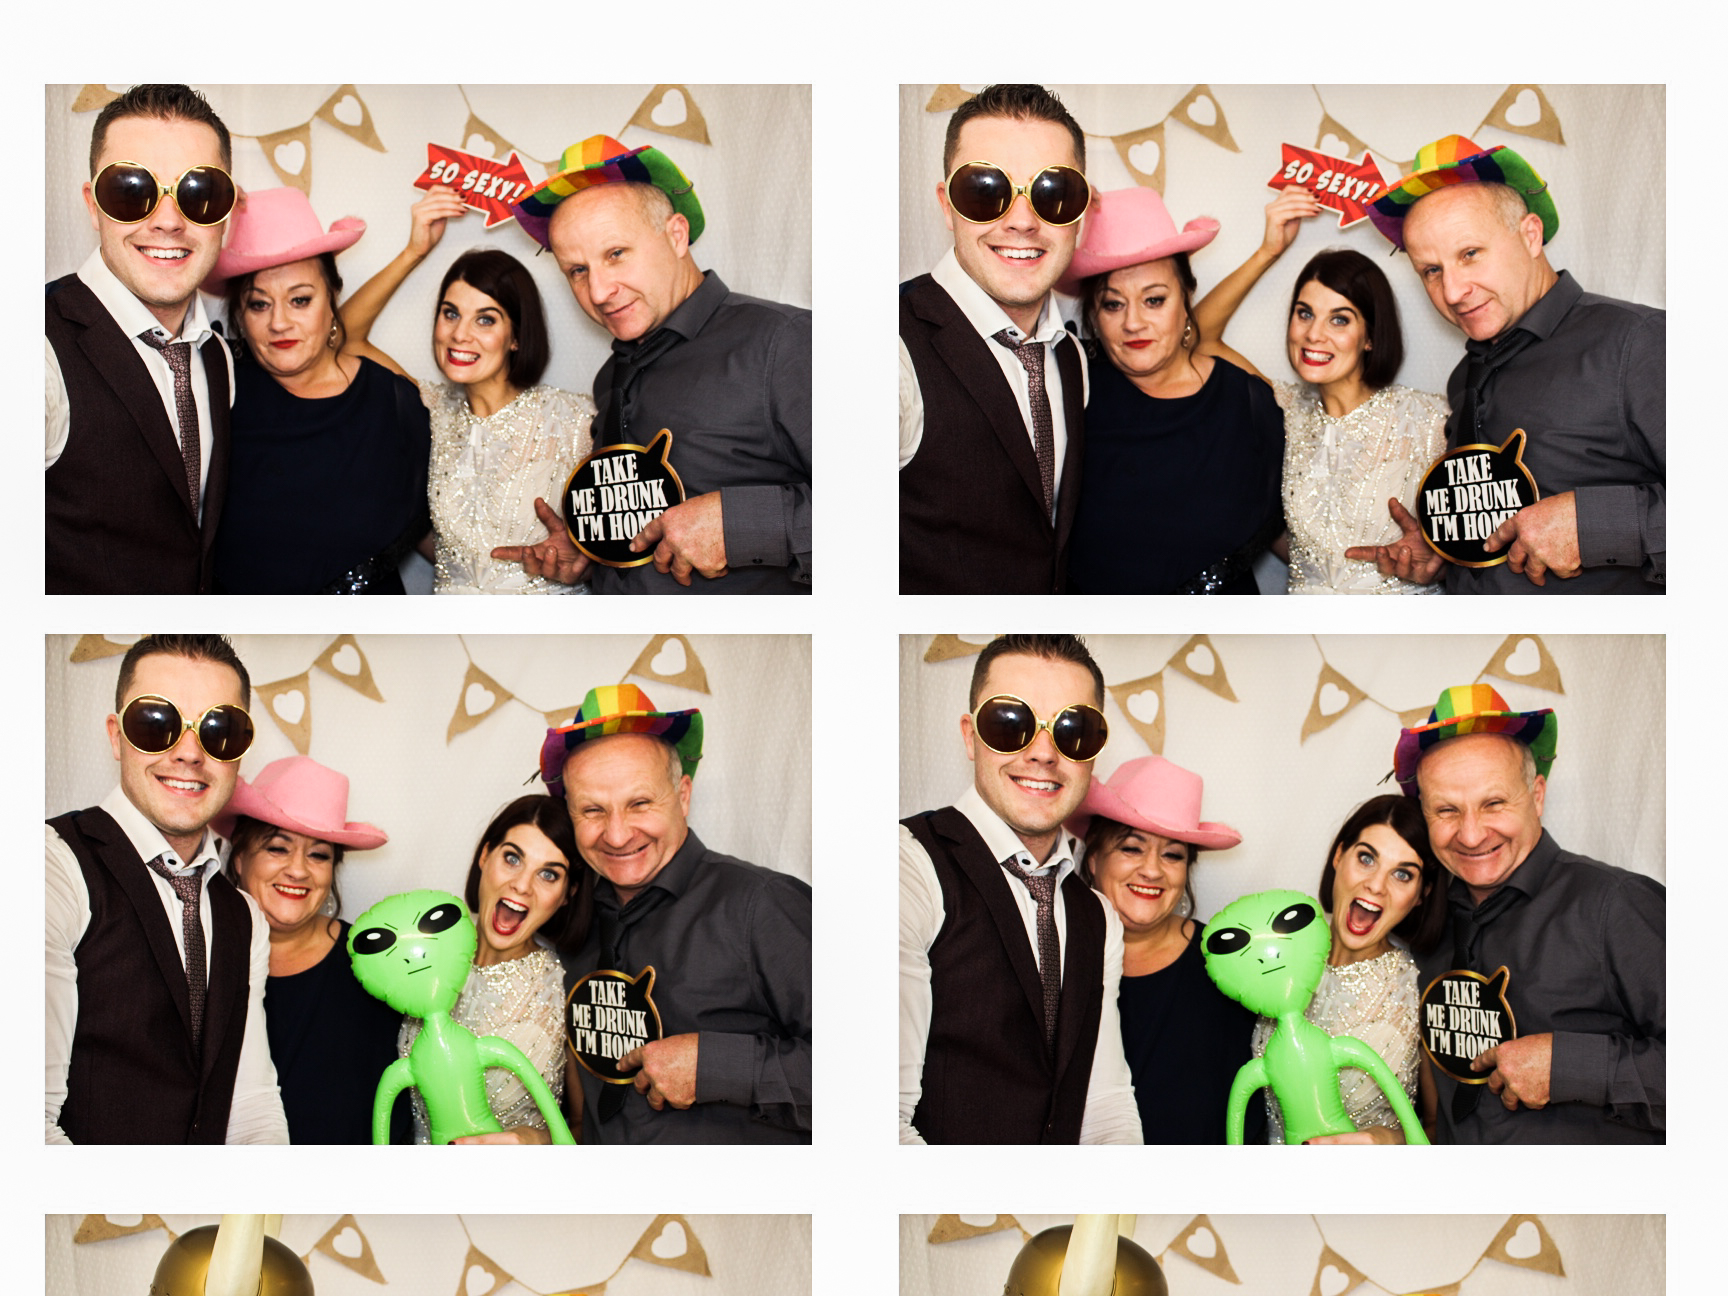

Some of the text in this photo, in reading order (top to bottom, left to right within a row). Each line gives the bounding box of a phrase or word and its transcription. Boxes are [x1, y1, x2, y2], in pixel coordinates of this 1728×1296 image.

[429, 159, 527, 204] SO SEXY!
[1283, 159, 1381, 204] SO SEXY!
[590, 453, 639, 486] TAKE
[1444, 453, 1493, 486] TAKE
[571, 478, 669, 516] ME DRUNK
[1425, 478, 1523, 516] ME DRUNK
[577, 509, 664, 542] I'M HOM
[1431, 509, 1518, 542] I'M HOM
[588, 980, 627, 1008] TAKE
[1442, 980, 1481, 1008] TAKE
[572, 1003, 649, 1039] ME DRUNK
[1426, 1003, 1503, 1039] ME DRUNK
[575, 1028, 645, 1061] I'M HOM
[1429, 1028, 1499, 1061] I'M HOM
